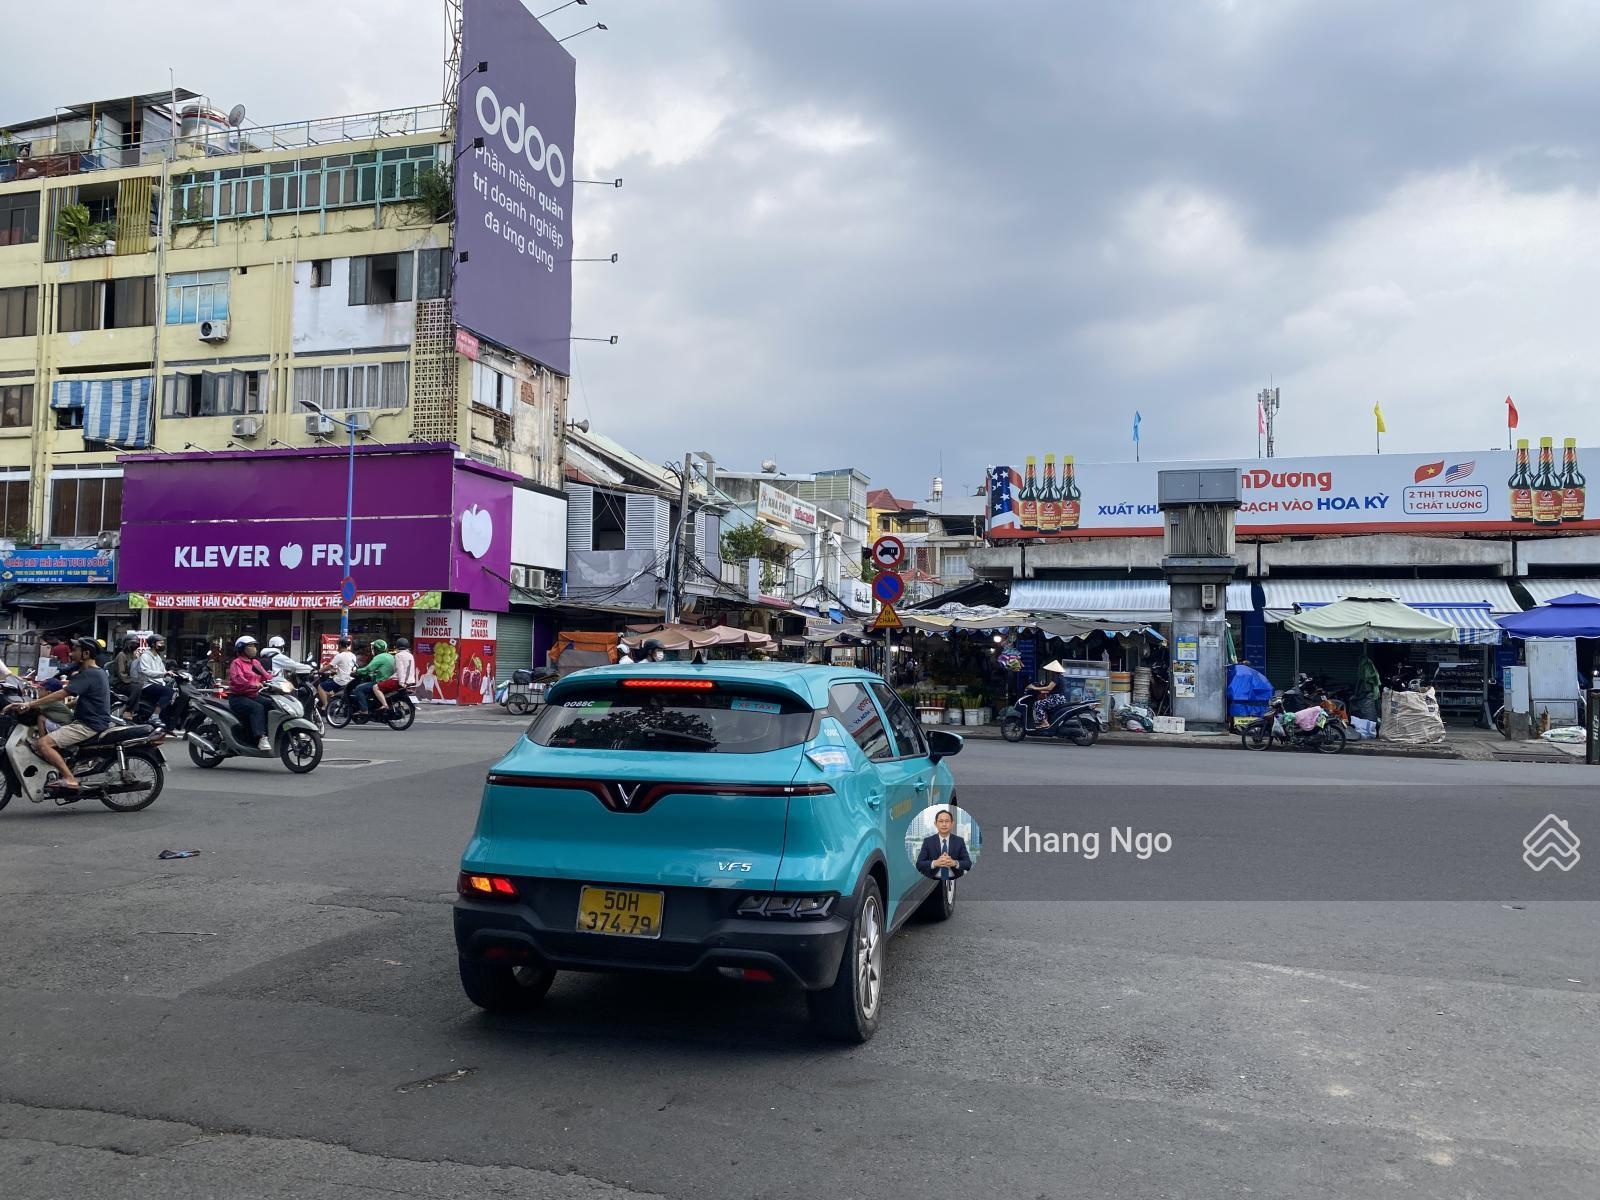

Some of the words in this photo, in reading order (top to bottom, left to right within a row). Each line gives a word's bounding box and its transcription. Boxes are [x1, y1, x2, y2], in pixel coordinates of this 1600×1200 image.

[475, 146, 506, 178] Phần
[509, 169, 536, 200] mềm
[539, 192, 563, 220] quản
[473, 171, 487, 200] trị
[491, 185, 526, 222] doanh
[530, 212, 563, 250] nghiệp
[485, 212, 499, 234] đa
[503, 221, 525, 253] ứng
[528, 240, 553, 272] dụng
[1417, 491, 1434, 499] THỊ
[1438, 488, 1482, 498] TRƯỜNG
[1098, 501, 1134, 515] XUẤT
[1282, 498, 1313, 511] VÀO
[1317, 496, 1360, 511] HOA
[1364, 492, 1390, 509] KỲ
[1416, 500, 1443, 510] CHẤT
[1447, 501, 1482, 510] LƯỢNG
[174, 546, 270, 568] KLEVER
[311, 543, 387, 566] FRUIT
[156, 596, 175, 607] NHO
[176, 596, 200, 607] SHINE
[222, 593, 248, 608] QUỐC
[249, 594, 273, 608] NHẬP
[274, 592, 299, 607] KHẨU
[301, 595, 323, 608] TRỰC
[350, 594, 375, 607] HÍNH
[377, 595, 410, 608] NGẠCH
[426, 617, 448, 626] SHINE
[471, 618, 489, 628] CHERRY
[421, 627, 453, 637] MUSCAT
[470, 629, 489, 638] CANADA
[604, 891, 640, 912] 50H
[586, 911, 652, 934] 374.79
